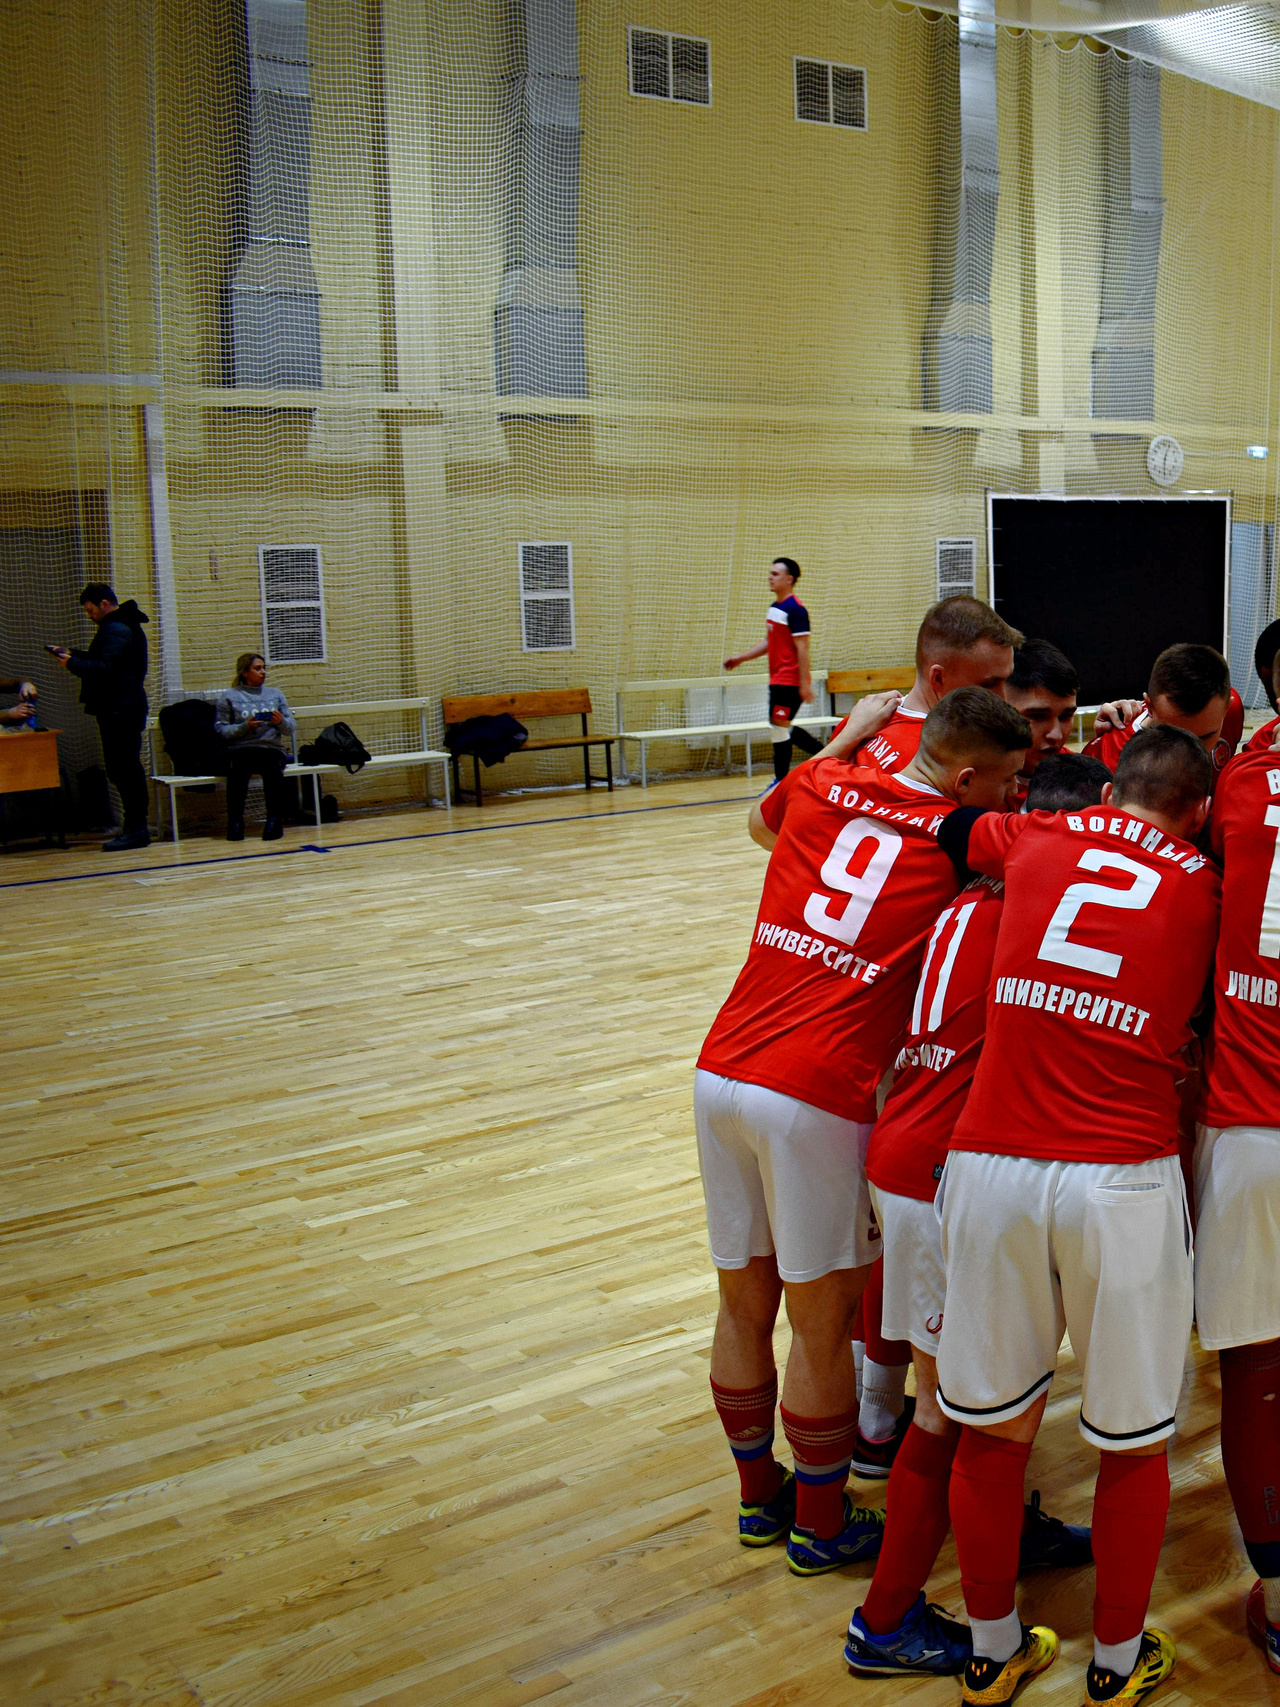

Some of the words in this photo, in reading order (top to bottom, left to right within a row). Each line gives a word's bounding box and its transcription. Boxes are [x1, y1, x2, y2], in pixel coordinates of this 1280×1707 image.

[803, 817, 903, 946] 9
[1067, 814, 1207, 875] ВОЕННЫЙ
[756, 921, 887, 984] УНИВЕРСИТЕ
[1037, 849, 1162, 978] 2
[911, 901, 977, 1035] 11
[995, 977, 1151, 1035] УНИВЕРСИТЕТ
